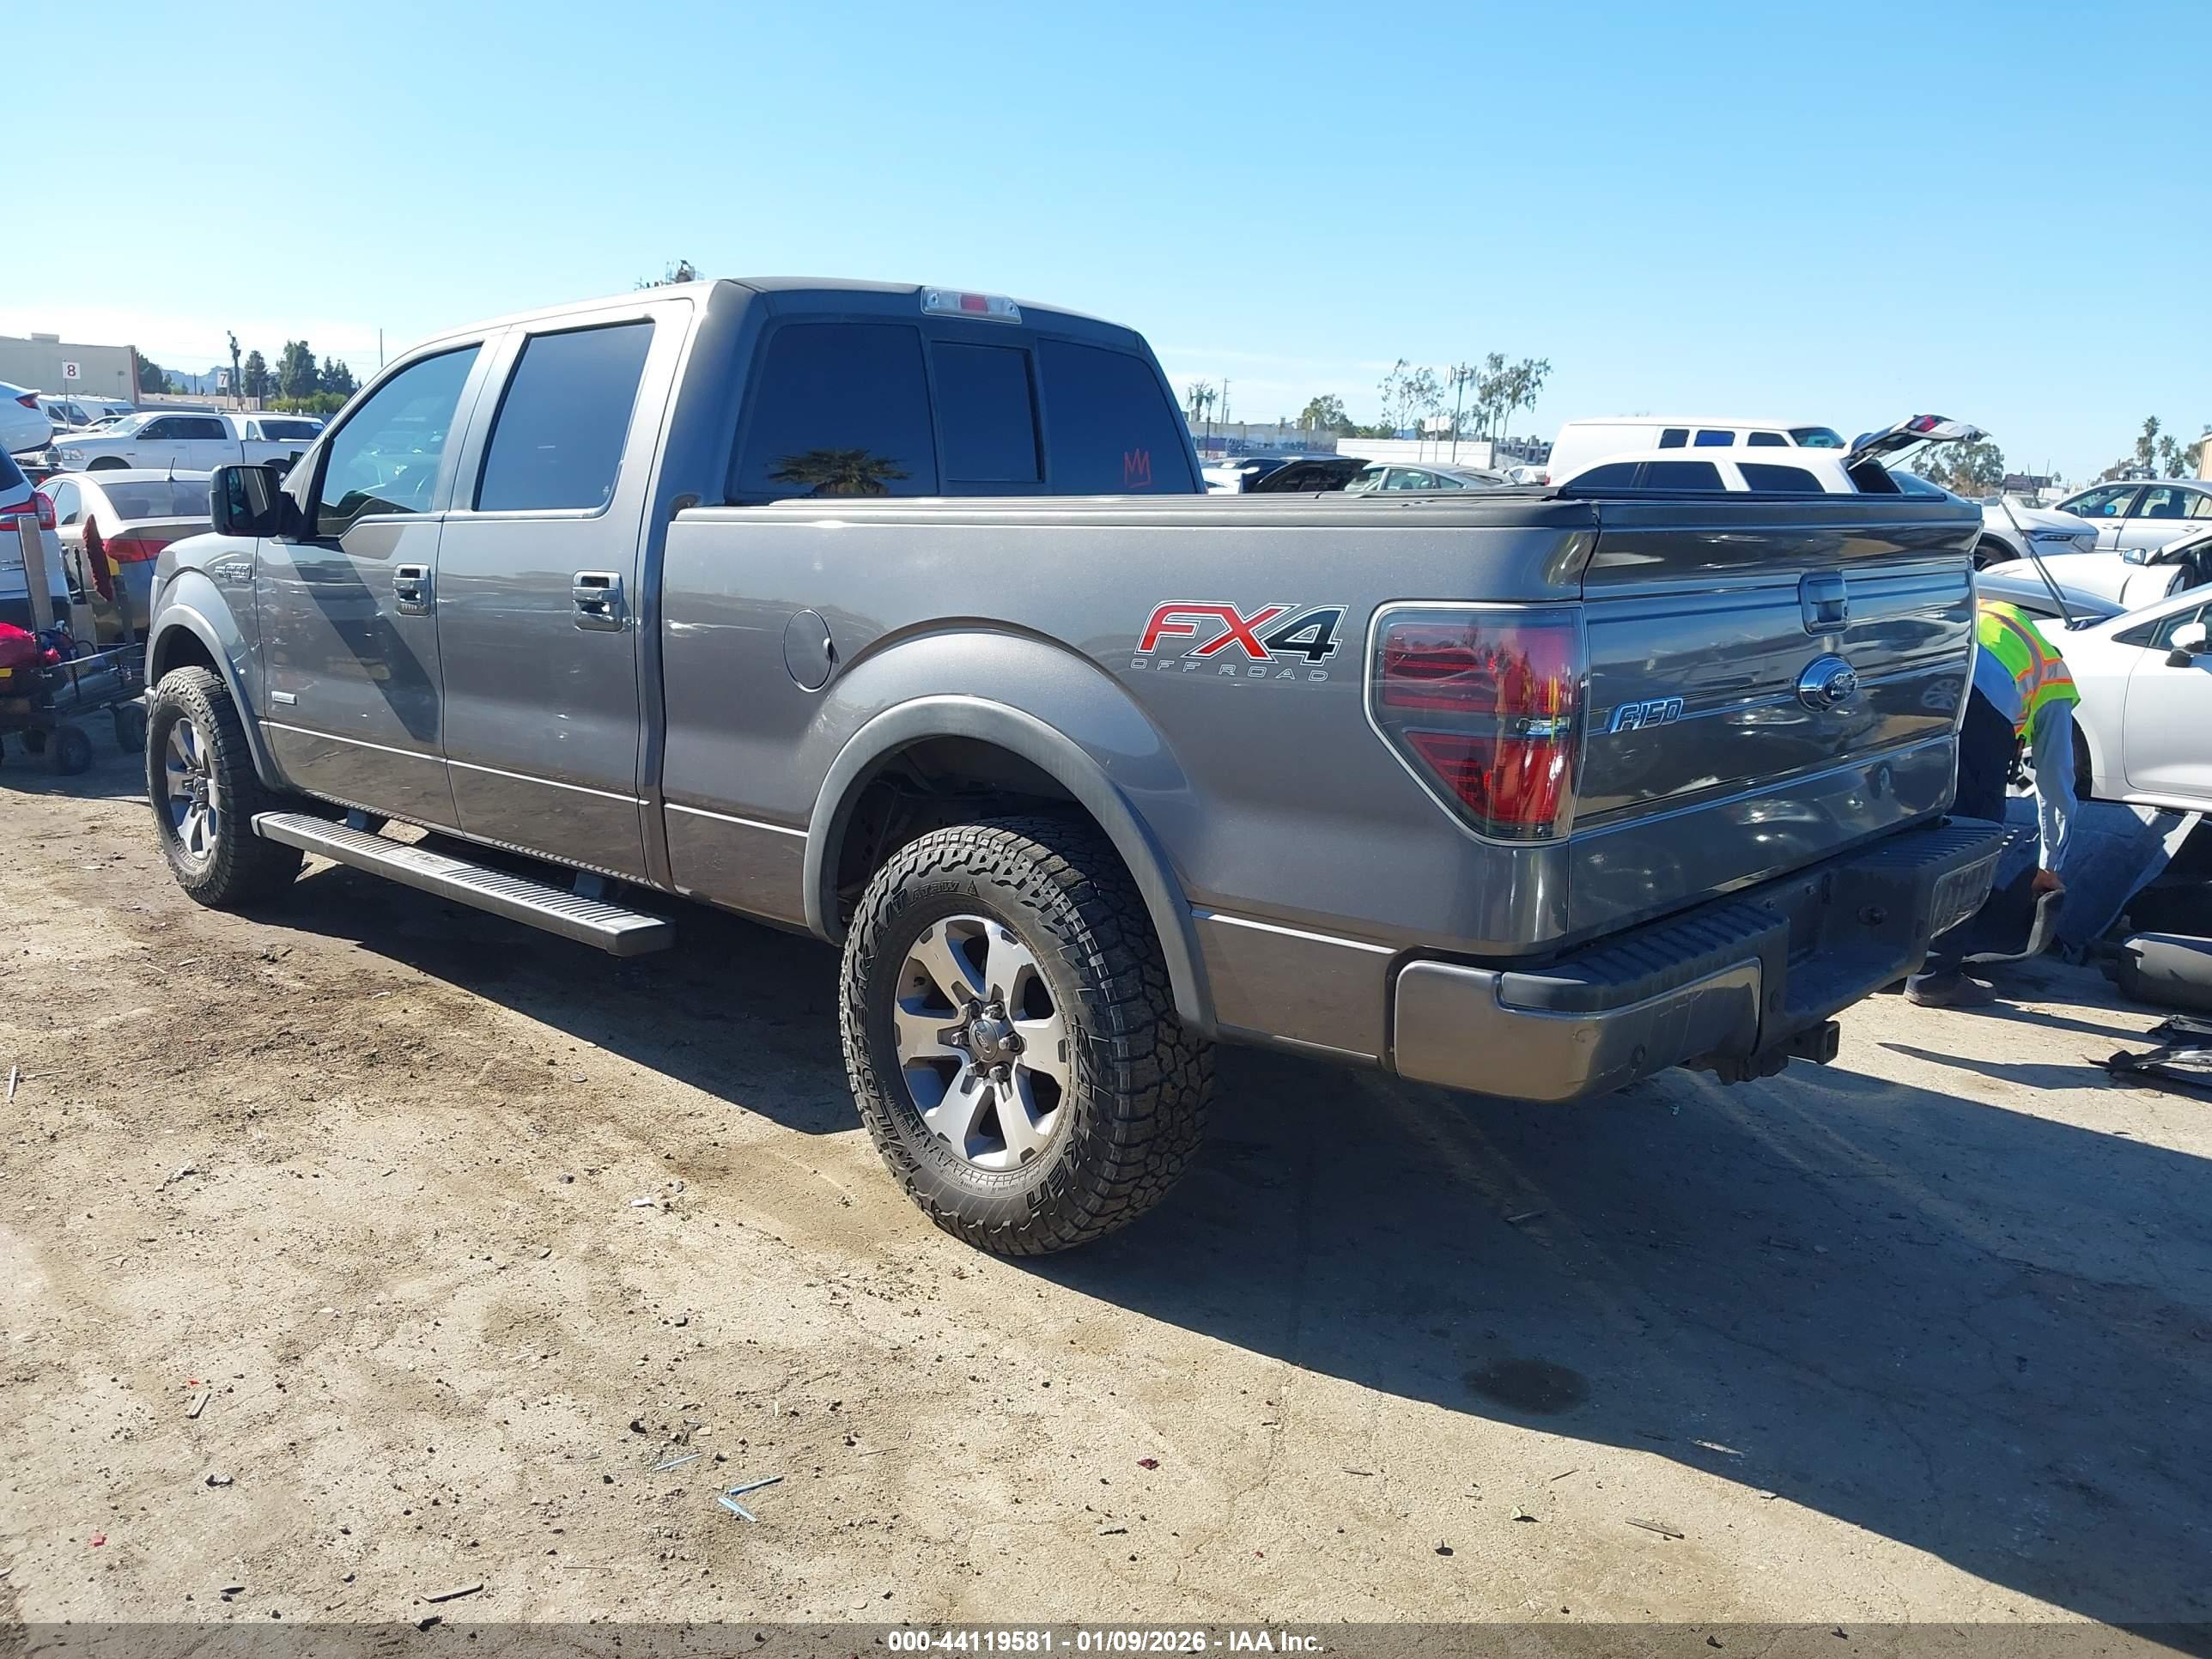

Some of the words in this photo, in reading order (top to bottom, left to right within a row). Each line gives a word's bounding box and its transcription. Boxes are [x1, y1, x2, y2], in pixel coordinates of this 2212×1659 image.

[67, 364, 76, 377] 8
[220, 374, 228, 386] 7
[1133, 599, 1350, 667] FX4
[1130, 658, 1201, 673] OFF
[1218, 664, 1329, 682] ROAD
